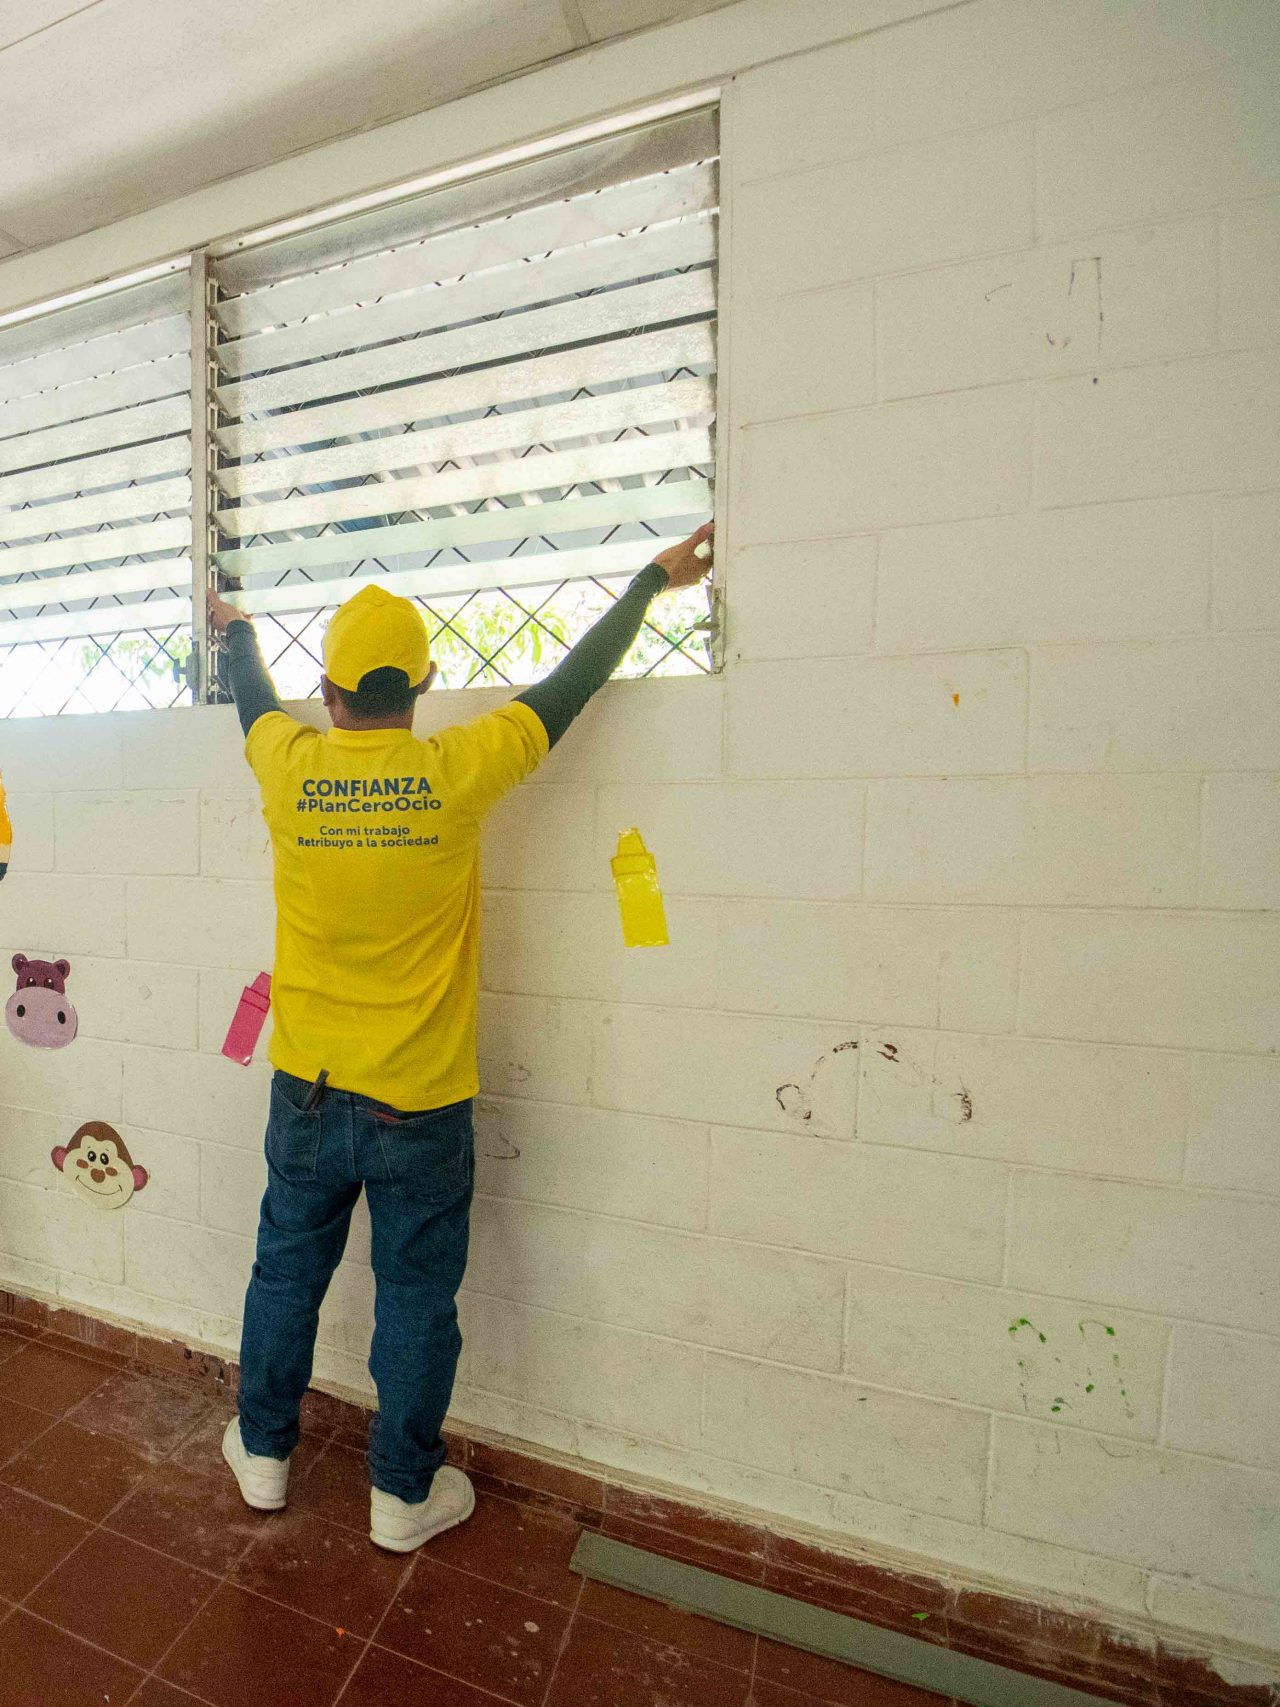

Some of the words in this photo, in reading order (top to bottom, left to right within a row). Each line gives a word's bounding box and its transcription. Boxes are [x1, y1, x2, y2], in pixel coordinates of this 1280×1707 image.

[303, 777, 432, 797] CONFIANZA
[297, 796, 442, 812] #PlanCeroOcio
[320, 826, 343, 836] Con
[346, 825, 361, 836] mi
[364, 825, 410, 837] trabajo
[298, 836, 353, 849] Retribuyo
[357, 839, 363, 848] a
[366, 838, 378, 847] la
[381, 835, 439, 847] sociedad
